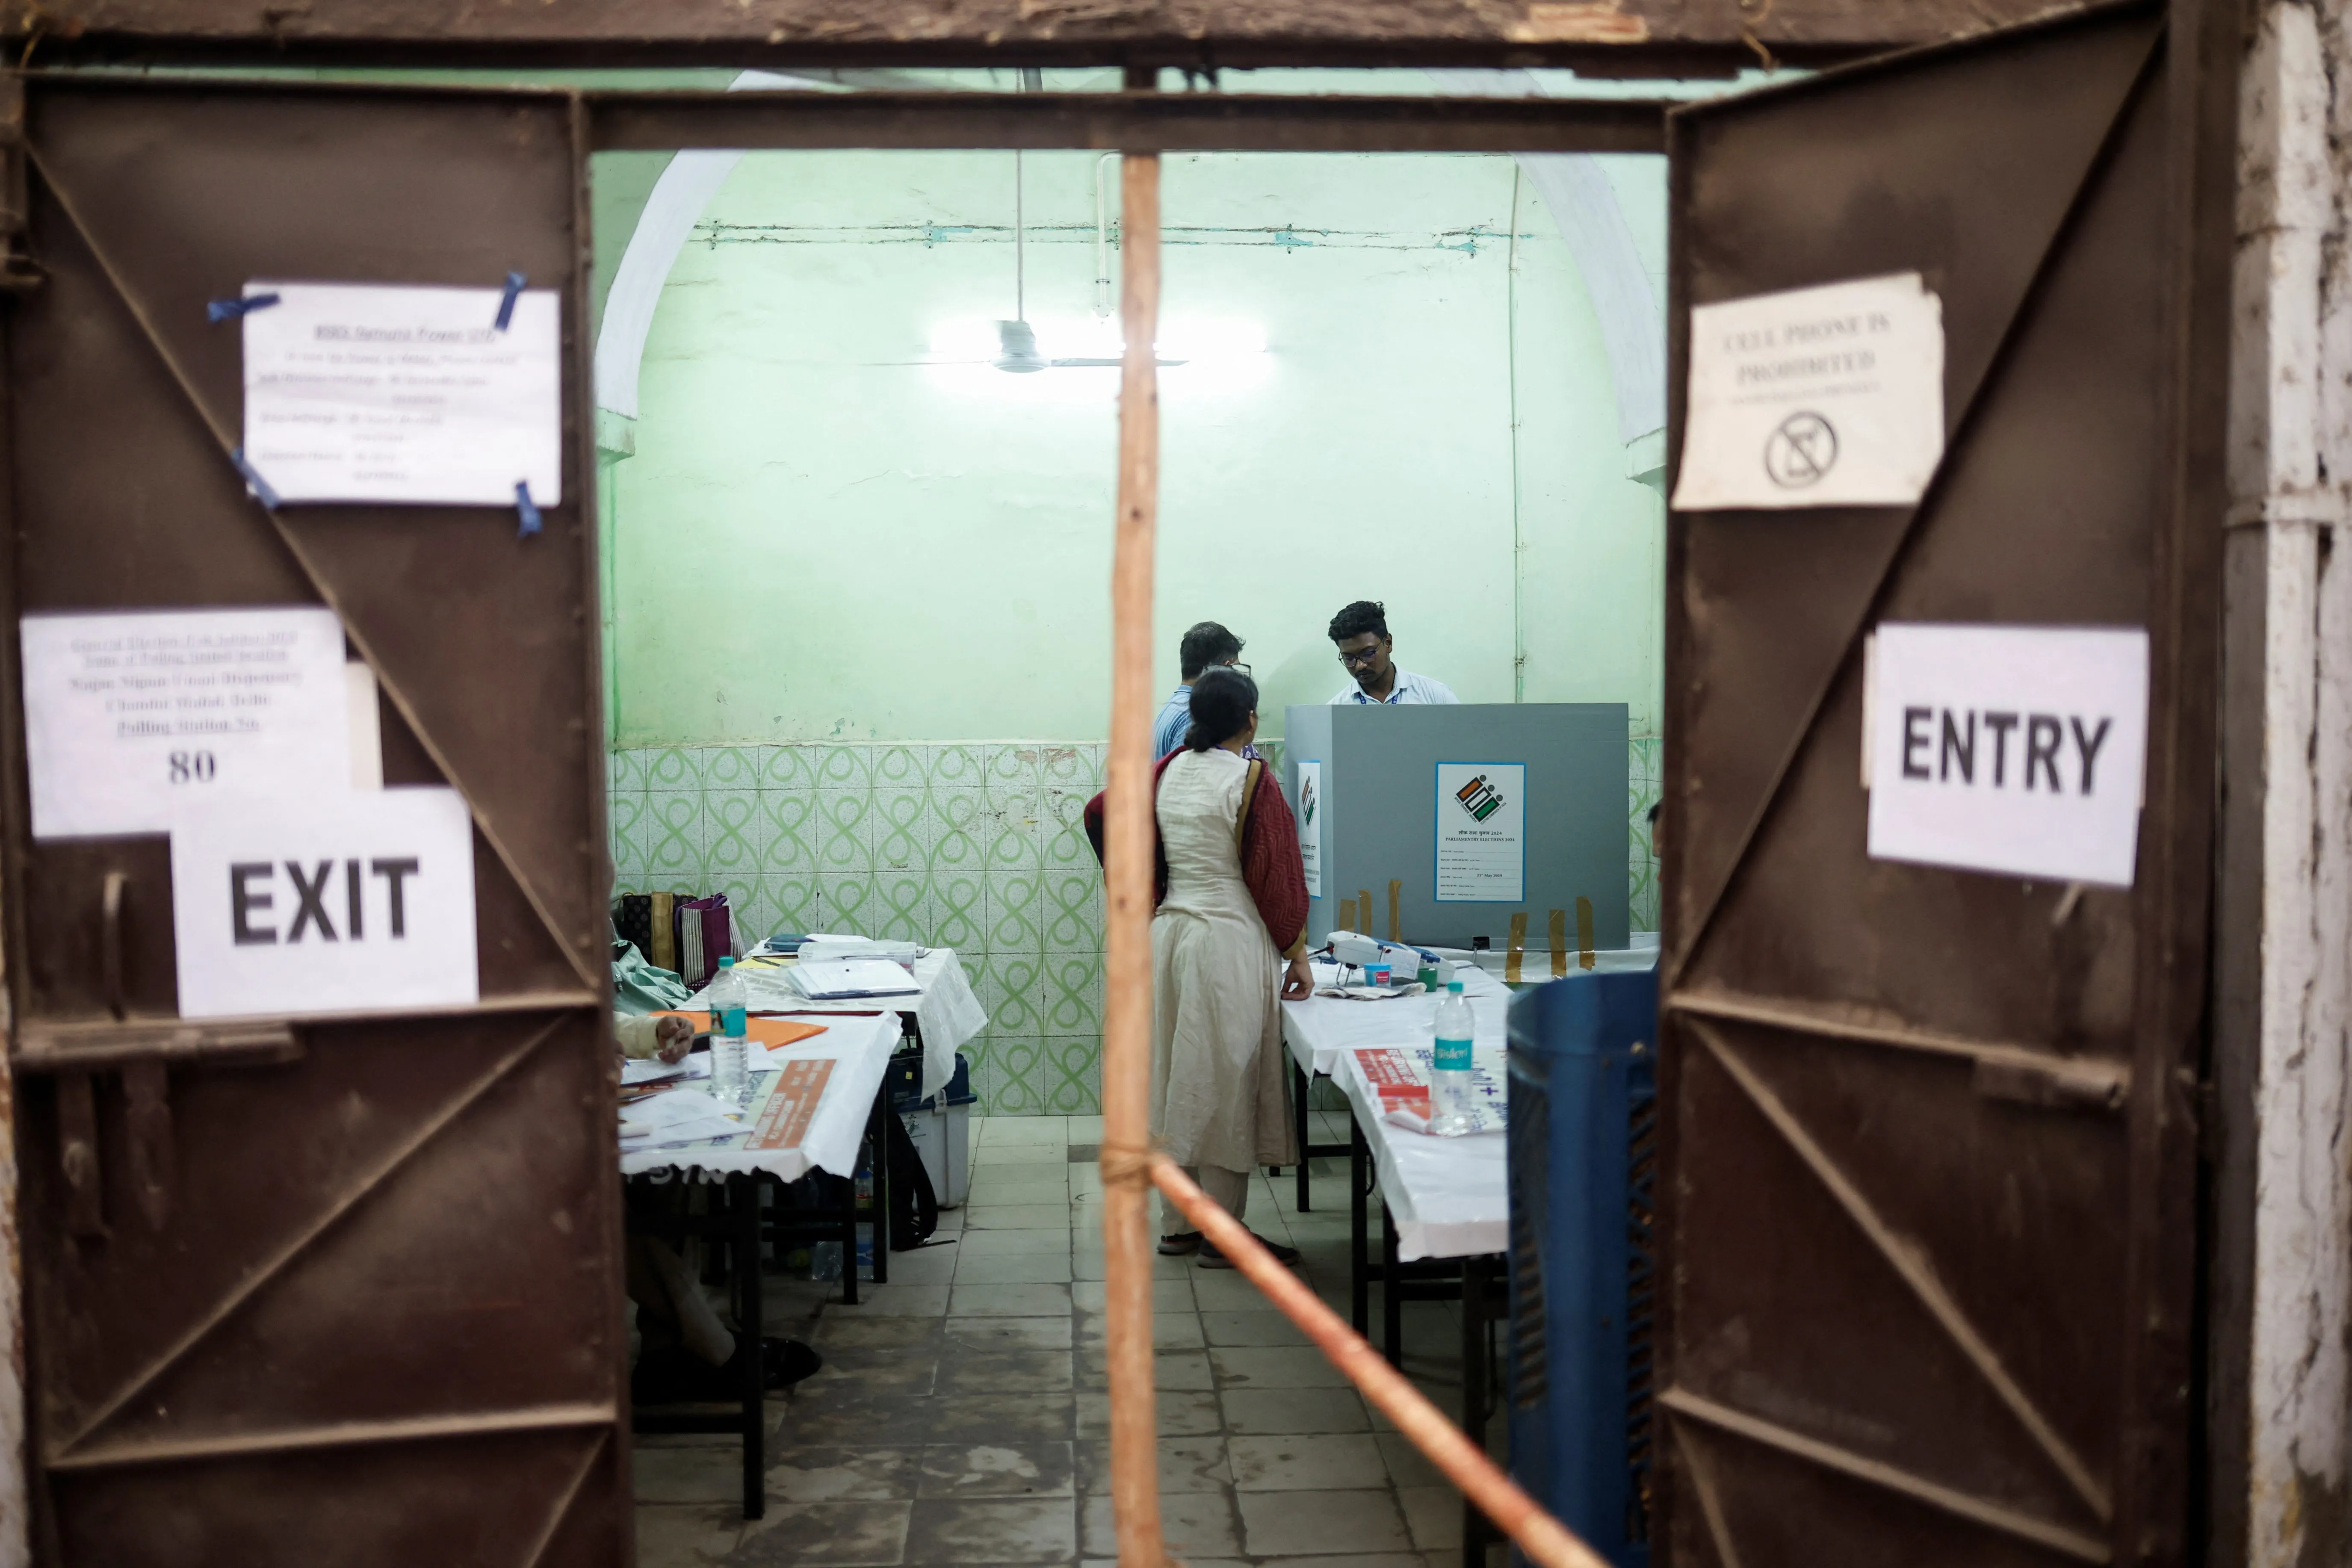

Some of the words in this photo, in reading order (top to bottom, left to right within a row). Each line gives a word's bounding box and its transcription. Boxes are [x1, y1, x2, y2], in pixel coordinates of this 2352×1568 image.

[168, 749, 218, 784] 80
[1903, 706, 2112, 797] ENTRY
[230, 855, 419, 946] EXIT
